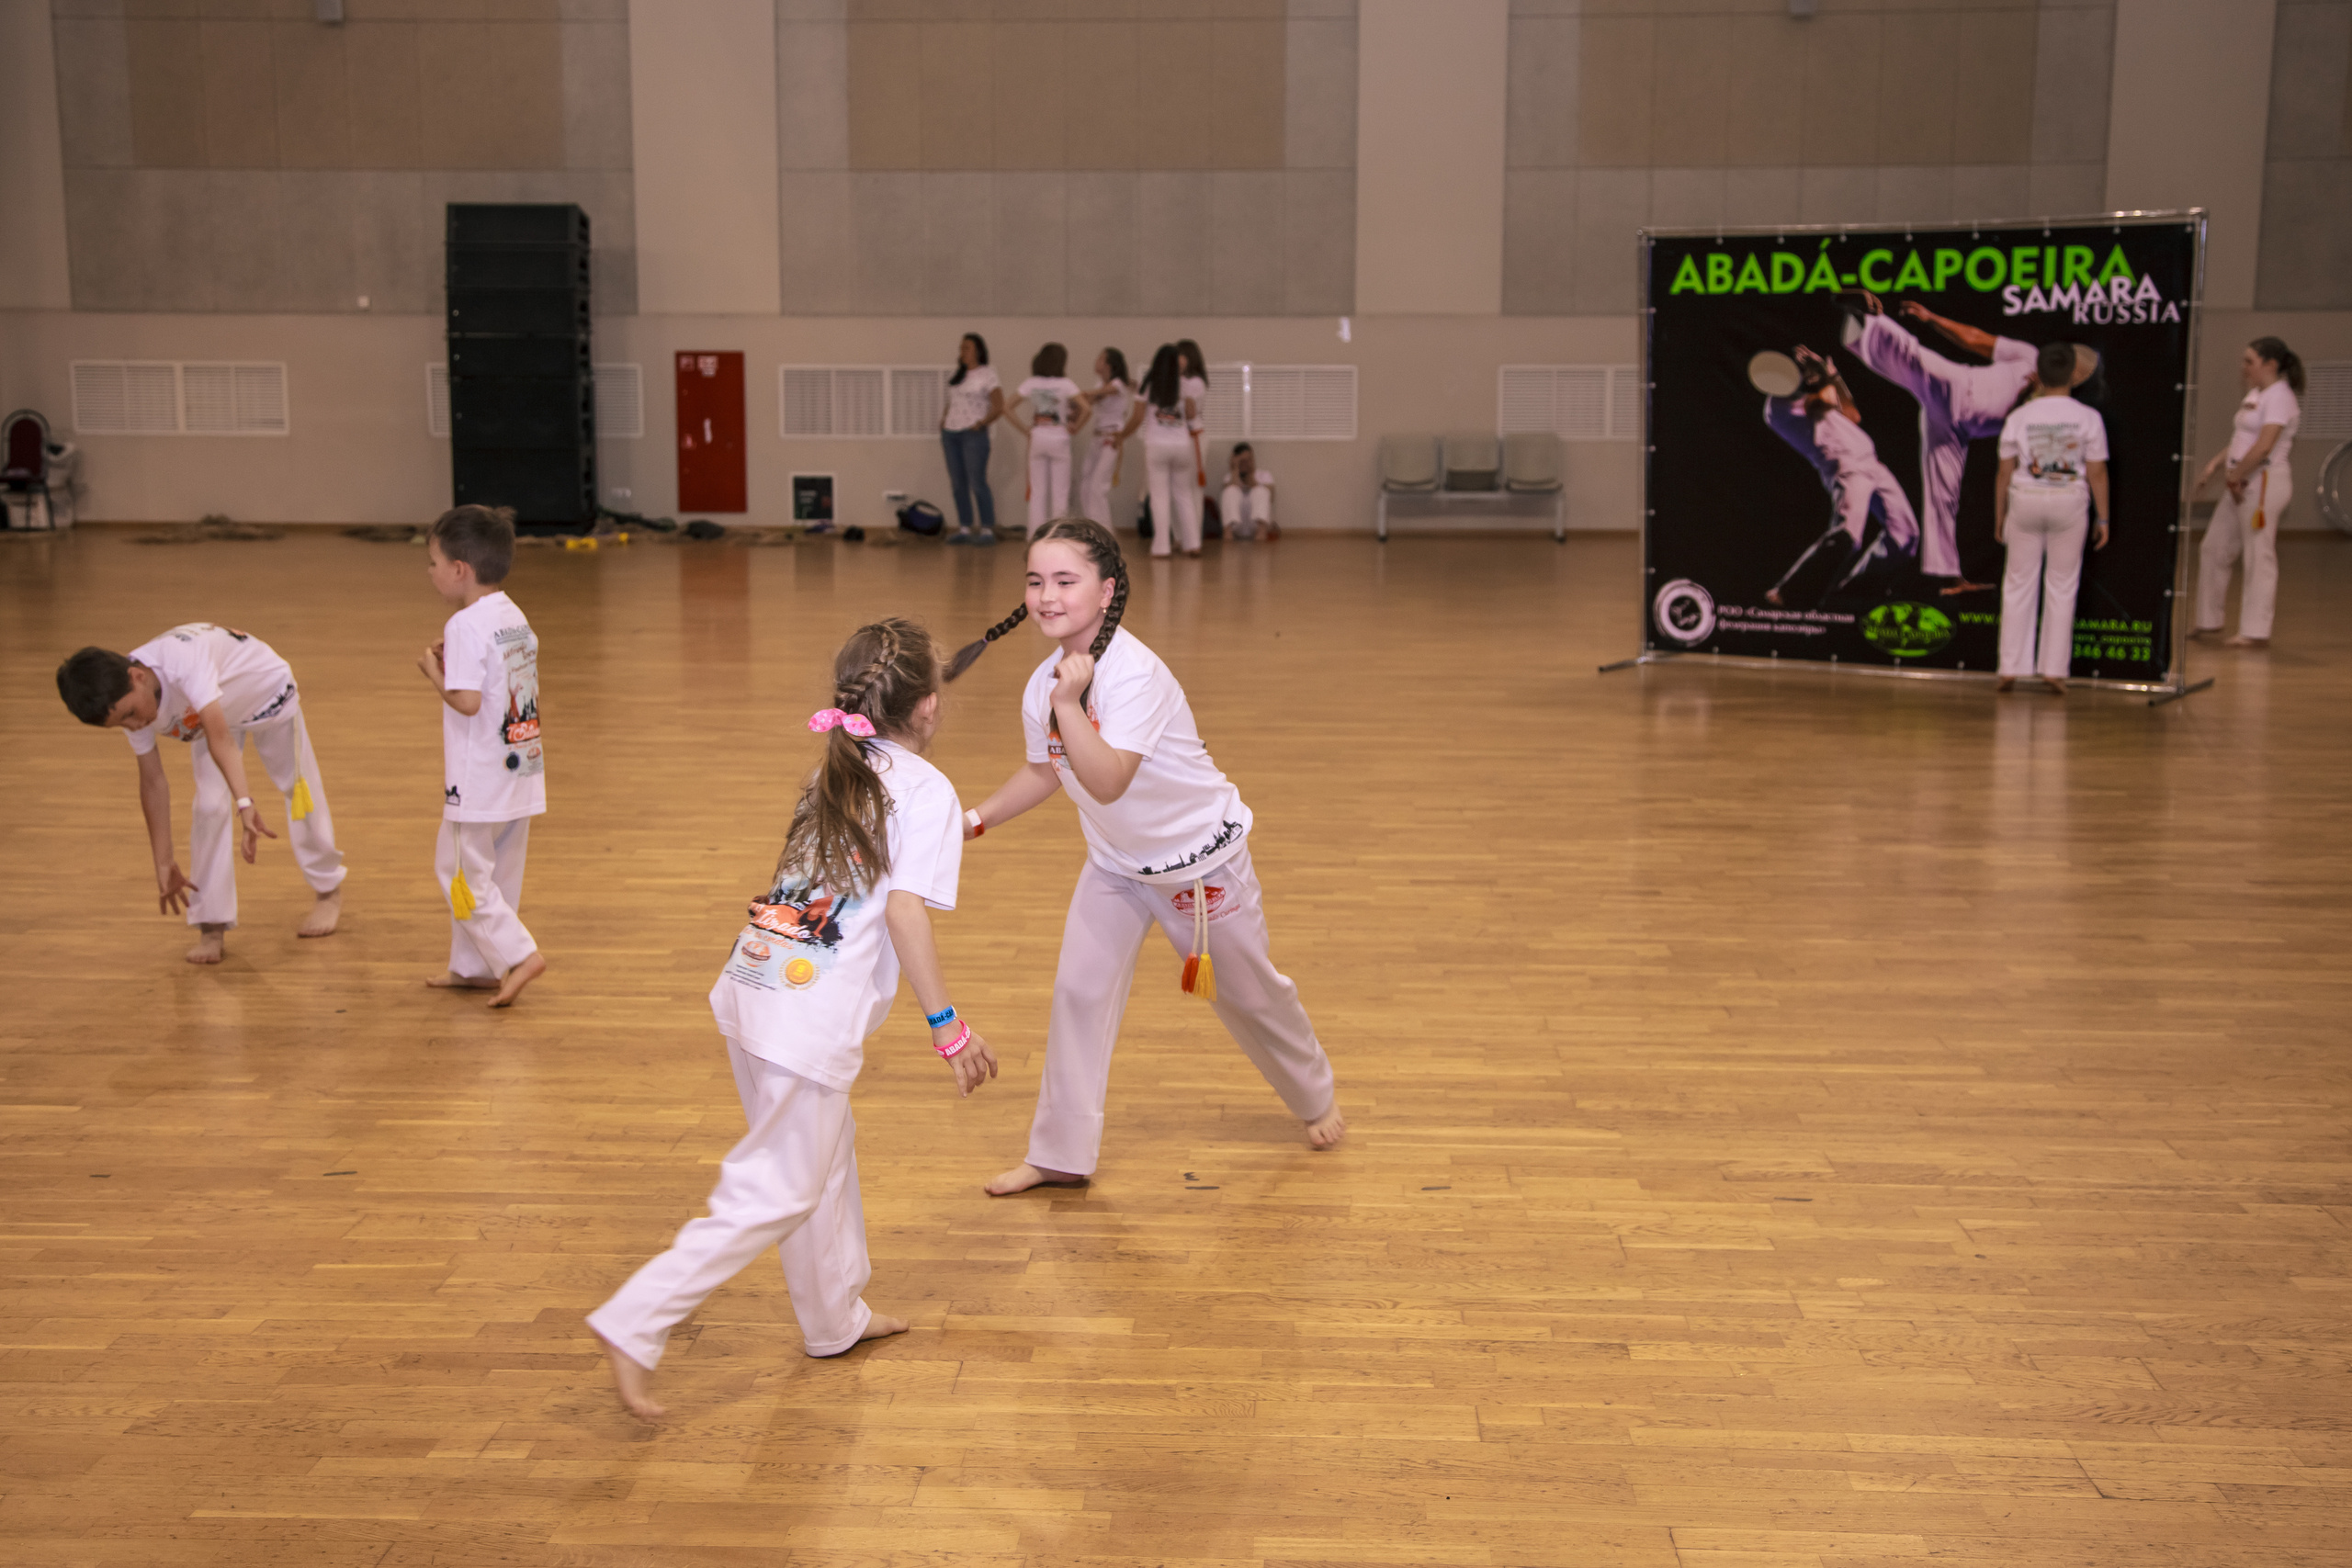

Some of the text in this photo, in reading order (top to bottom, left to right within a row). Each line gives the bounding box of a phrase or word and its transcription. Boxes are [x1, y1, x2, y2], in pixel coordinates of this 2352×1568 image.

[1669, 238, 2137, 295] ABADÁ-CAPOEIRA
[2003, 273, 2161, 316] SAMARA
[2073, 300, 2181, 324] RUSSIA
